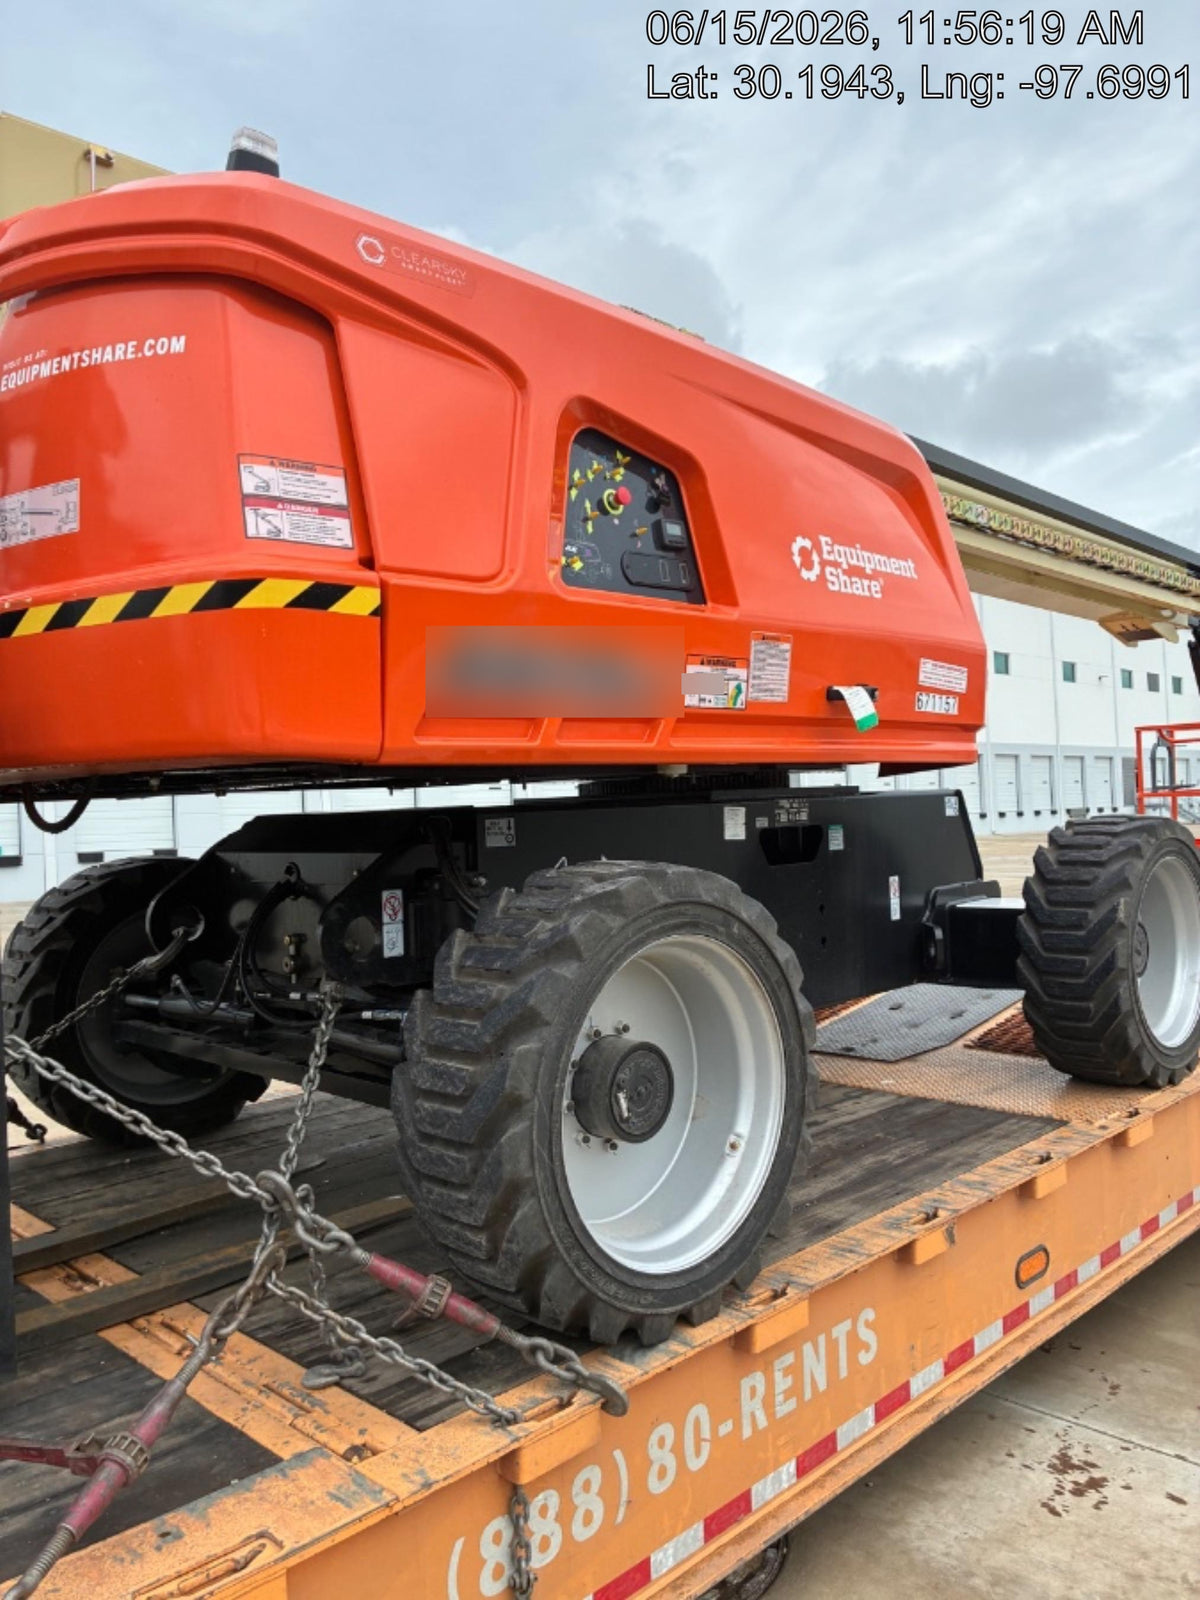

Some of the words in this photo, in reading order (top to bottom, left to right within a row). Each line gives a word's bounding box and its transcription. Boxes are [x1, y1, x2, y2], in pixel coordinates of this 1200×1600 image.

[0, 335, 186, 392] EQUIPMENTSHARE.COM
[818, 534, 918, 579] Equipment
[447, 1448, 630, 1600] (888)
[646, 1307, 879, 1495] 80-RENTS
